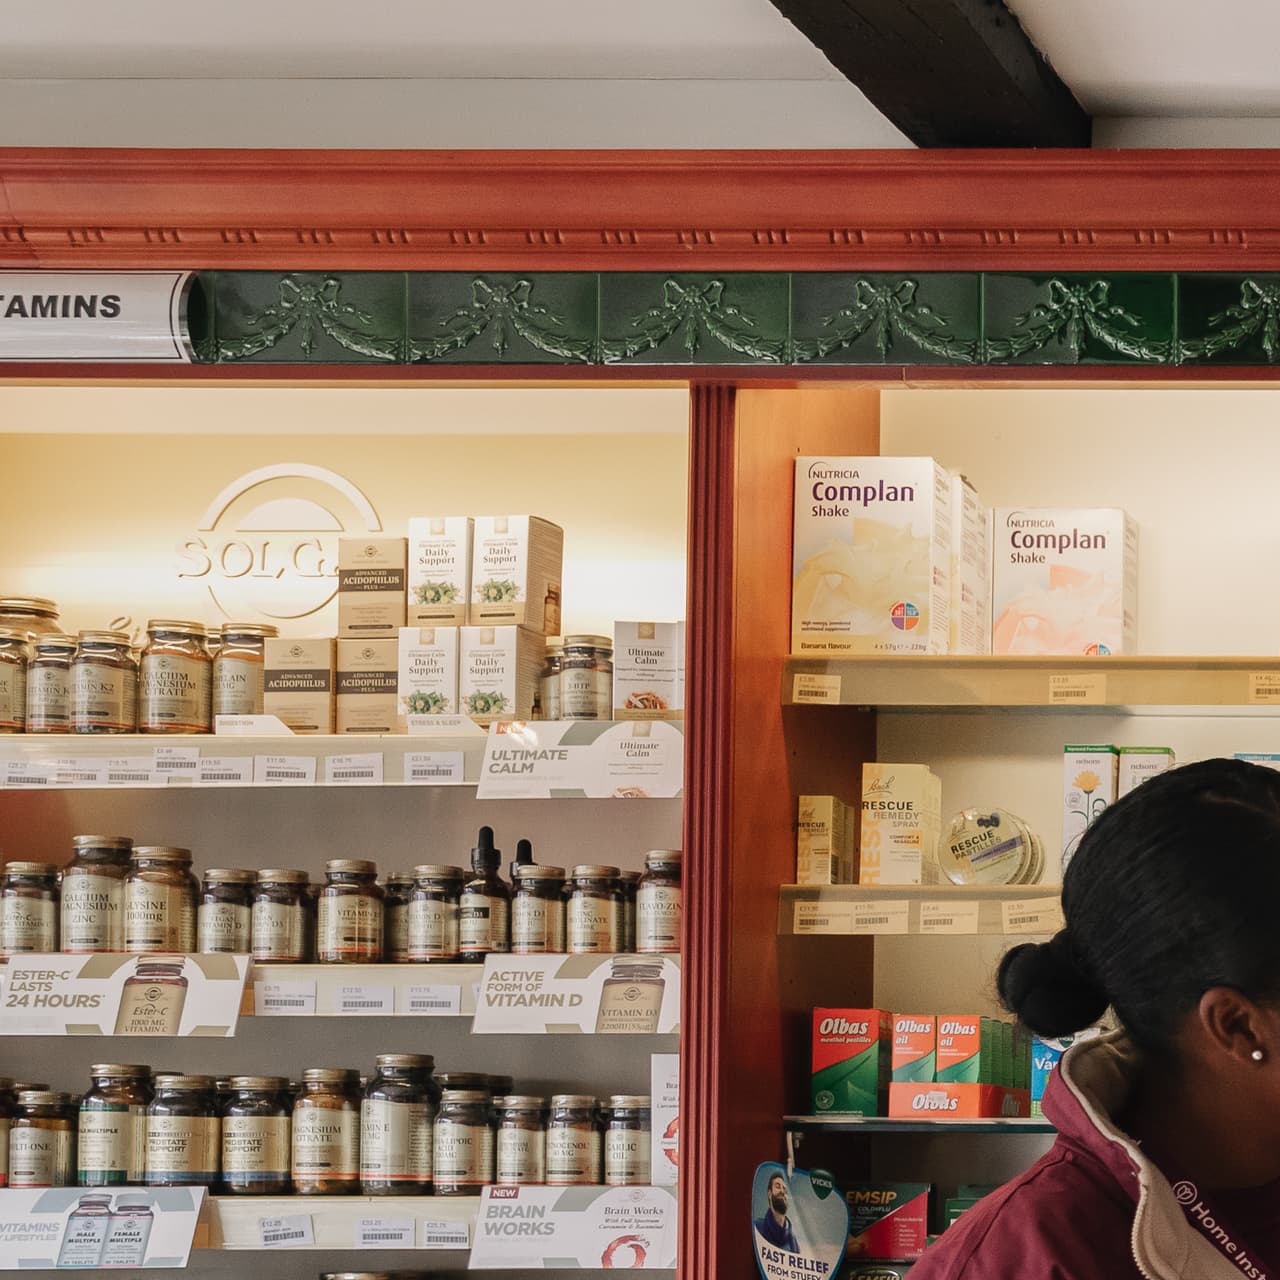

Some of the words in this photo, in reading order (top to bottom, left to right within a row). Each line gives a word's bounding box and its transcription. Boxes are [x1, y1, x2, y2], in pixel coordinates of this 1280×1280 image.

[813, 470, 860, 479] NUTRICIA
[812, 480, 914, 507] Complan
[811, 505, 849, 517] Shake
[1010, 519, 1055, 528] NUTRICIA
[1010, 528, 1107, 554] Complan
[1010, 552, 1046, 564] Shake
[490, 749, 568, 761] ULTIMATE
[488, 762, 534, 774] CALM
[862, 801, 914, 812] RESCUE
[873, 811, 921, 821] REMEDY
[950, 830, 996, 854] RESCUE
[12, 970, 70, 980] ESTER-C
[489, 971, 544, 982] ACTIVE
[9, 982, 52, 992] LASTS
[486, 983, 522, 993] FORM
[525, 983, 543, 993] OF
[485, 993, 564, 1007] VITAMIN
[568, 994, 583, 1007] D
[820, 1018, 869, 1035] Olbas
[895, 1019, 931, 1034] Olbas
[940, 1022, 976, 1036] Olbas
[896, 1034, 908, 1045] oil
[941, 1037, 953, 1047] oil
[493, 1189, 517, 1198] NEW
[486, 1205, 546, 1219] BRAIN
[484, 1222, 555, 1236] WORKS
[1191, 1201, 1237, 1251] Home
[762, 1247, 785, 1265] FAST
[789, 1255, 829, 1274] RELIEF
[768, 1265, 789, 1277] FROM
